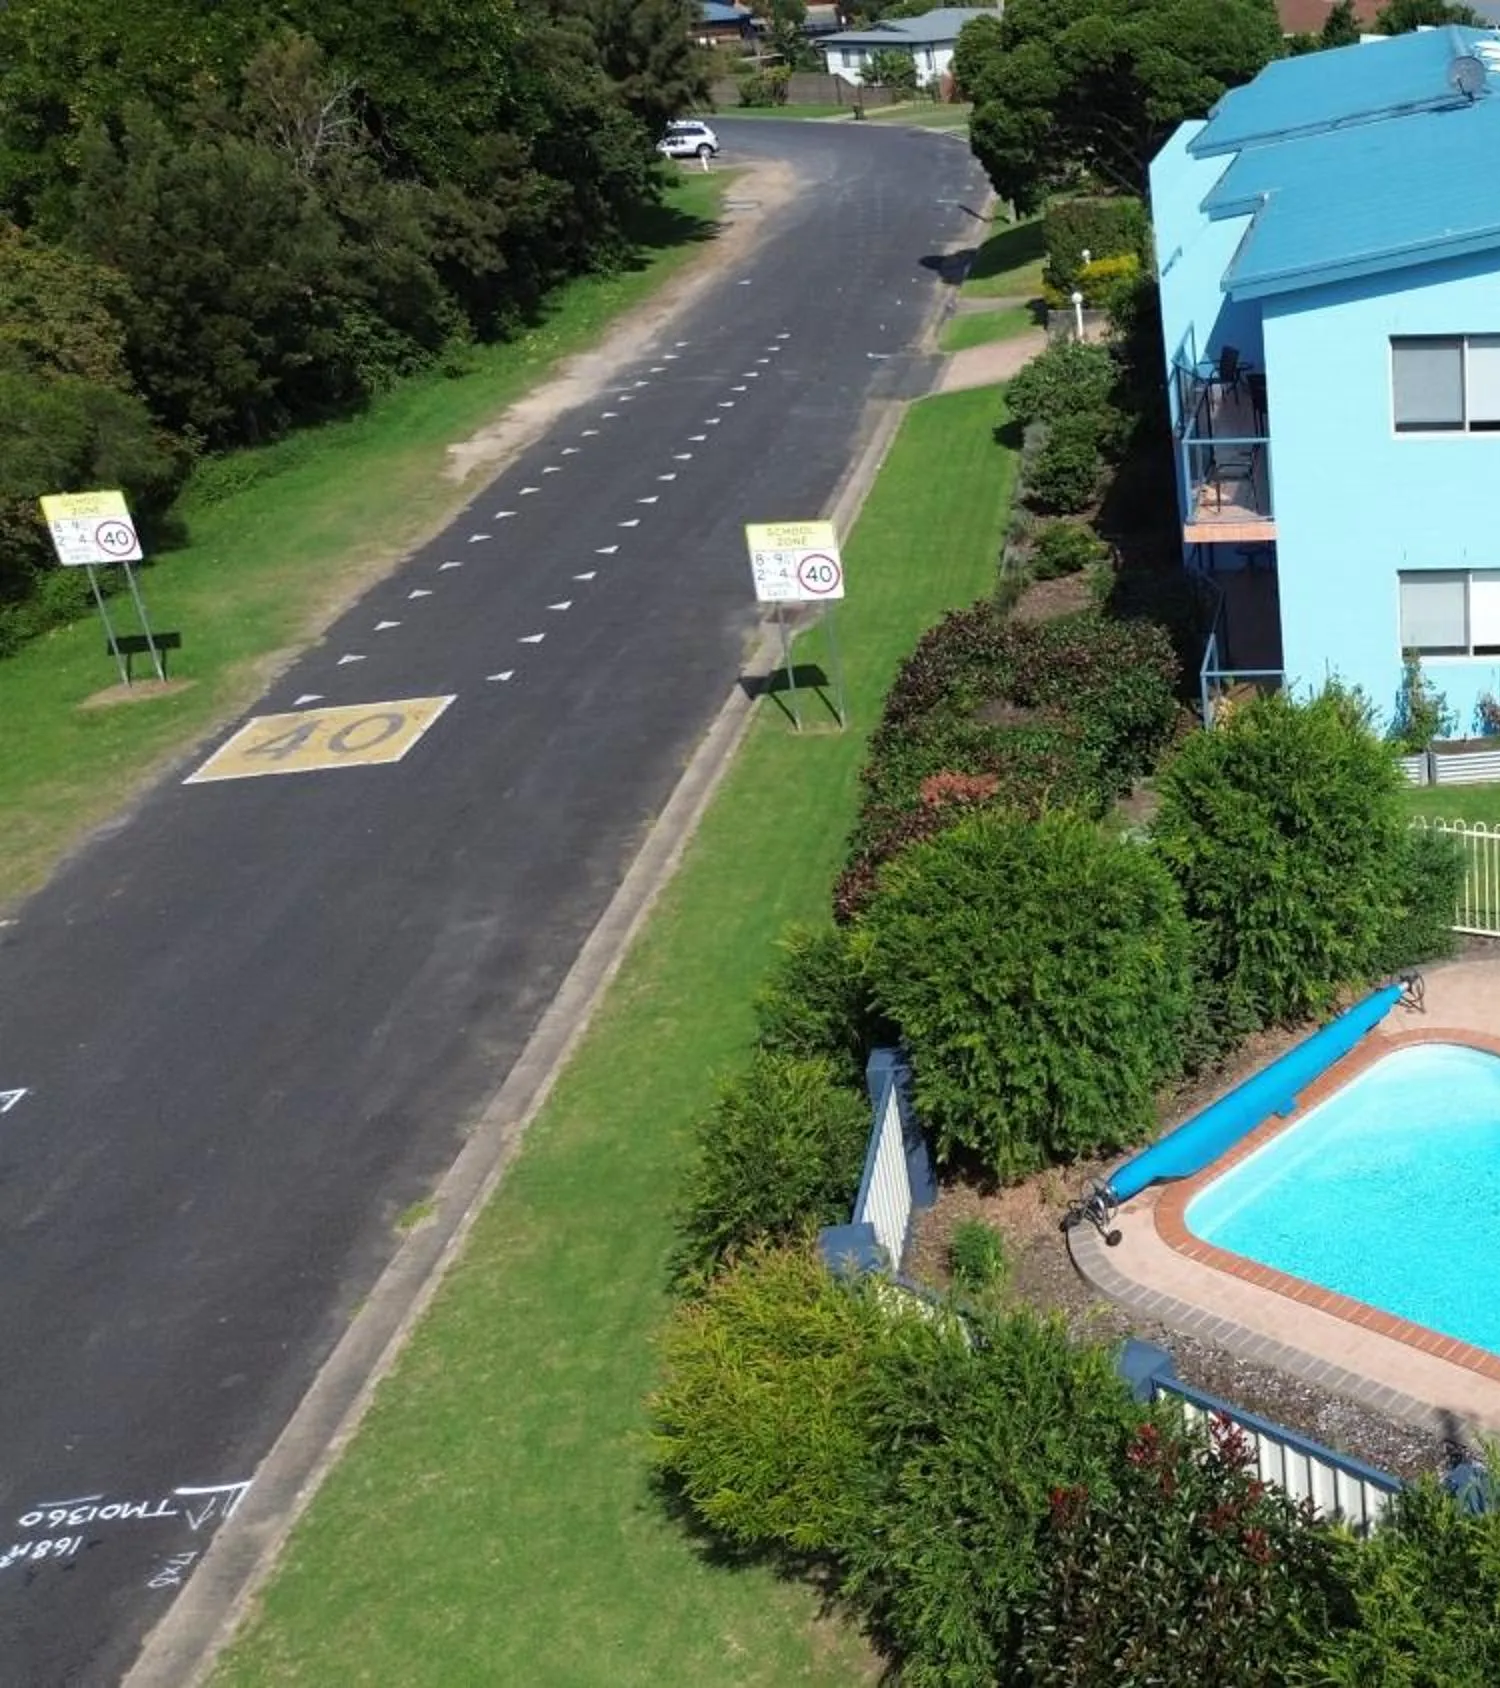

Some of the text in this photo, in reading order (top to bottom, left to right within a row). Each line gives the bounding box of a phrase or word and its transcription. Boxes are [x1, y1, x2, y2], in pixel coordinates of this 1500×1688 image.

[103, 529, 129, 547] 40
[805, 565, 833, 583] 40
[243, 712, 406, 761] 40
